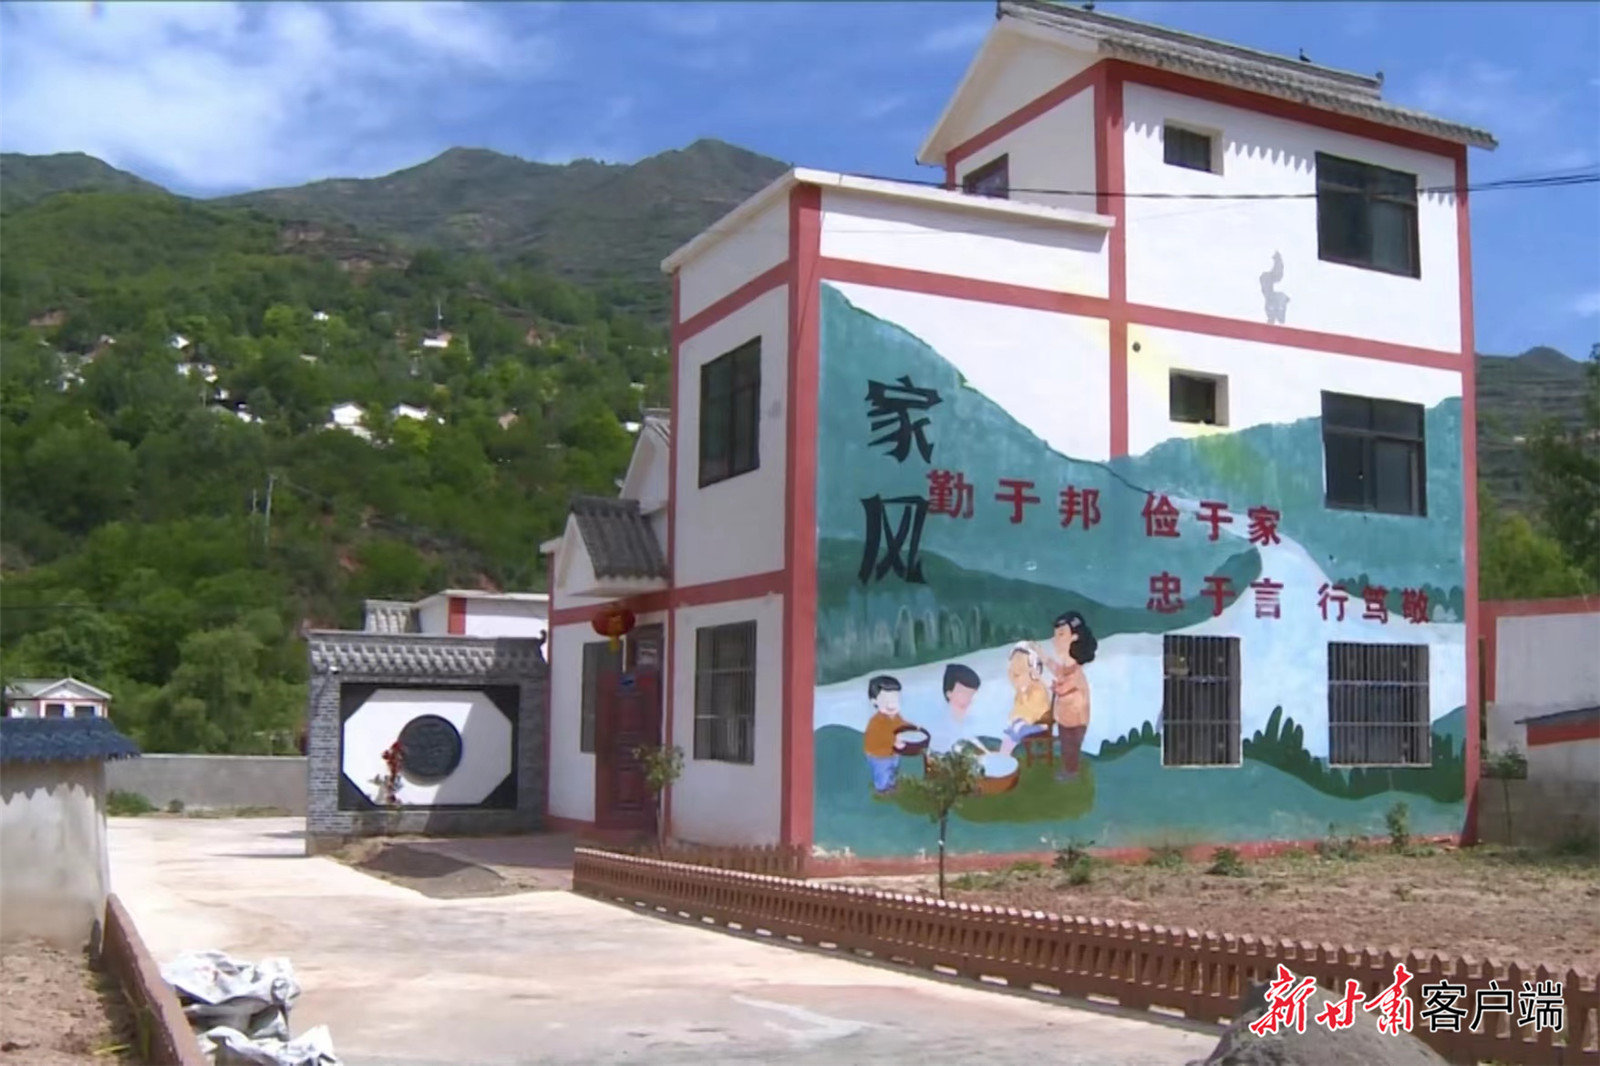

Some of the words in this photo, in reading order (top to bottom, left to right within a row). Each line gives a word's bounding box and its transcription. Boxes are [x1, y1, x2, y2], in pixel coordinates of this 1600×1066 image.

[859, 375, 943, 585] 家风
[926, 469, 1101, 531] 勤于邦
[1141, 490, 1281, 546] 俭于家
[1146, 571, 1284, 619] 忠于言
[1317, 582, 1429, 624] 行笃敬
